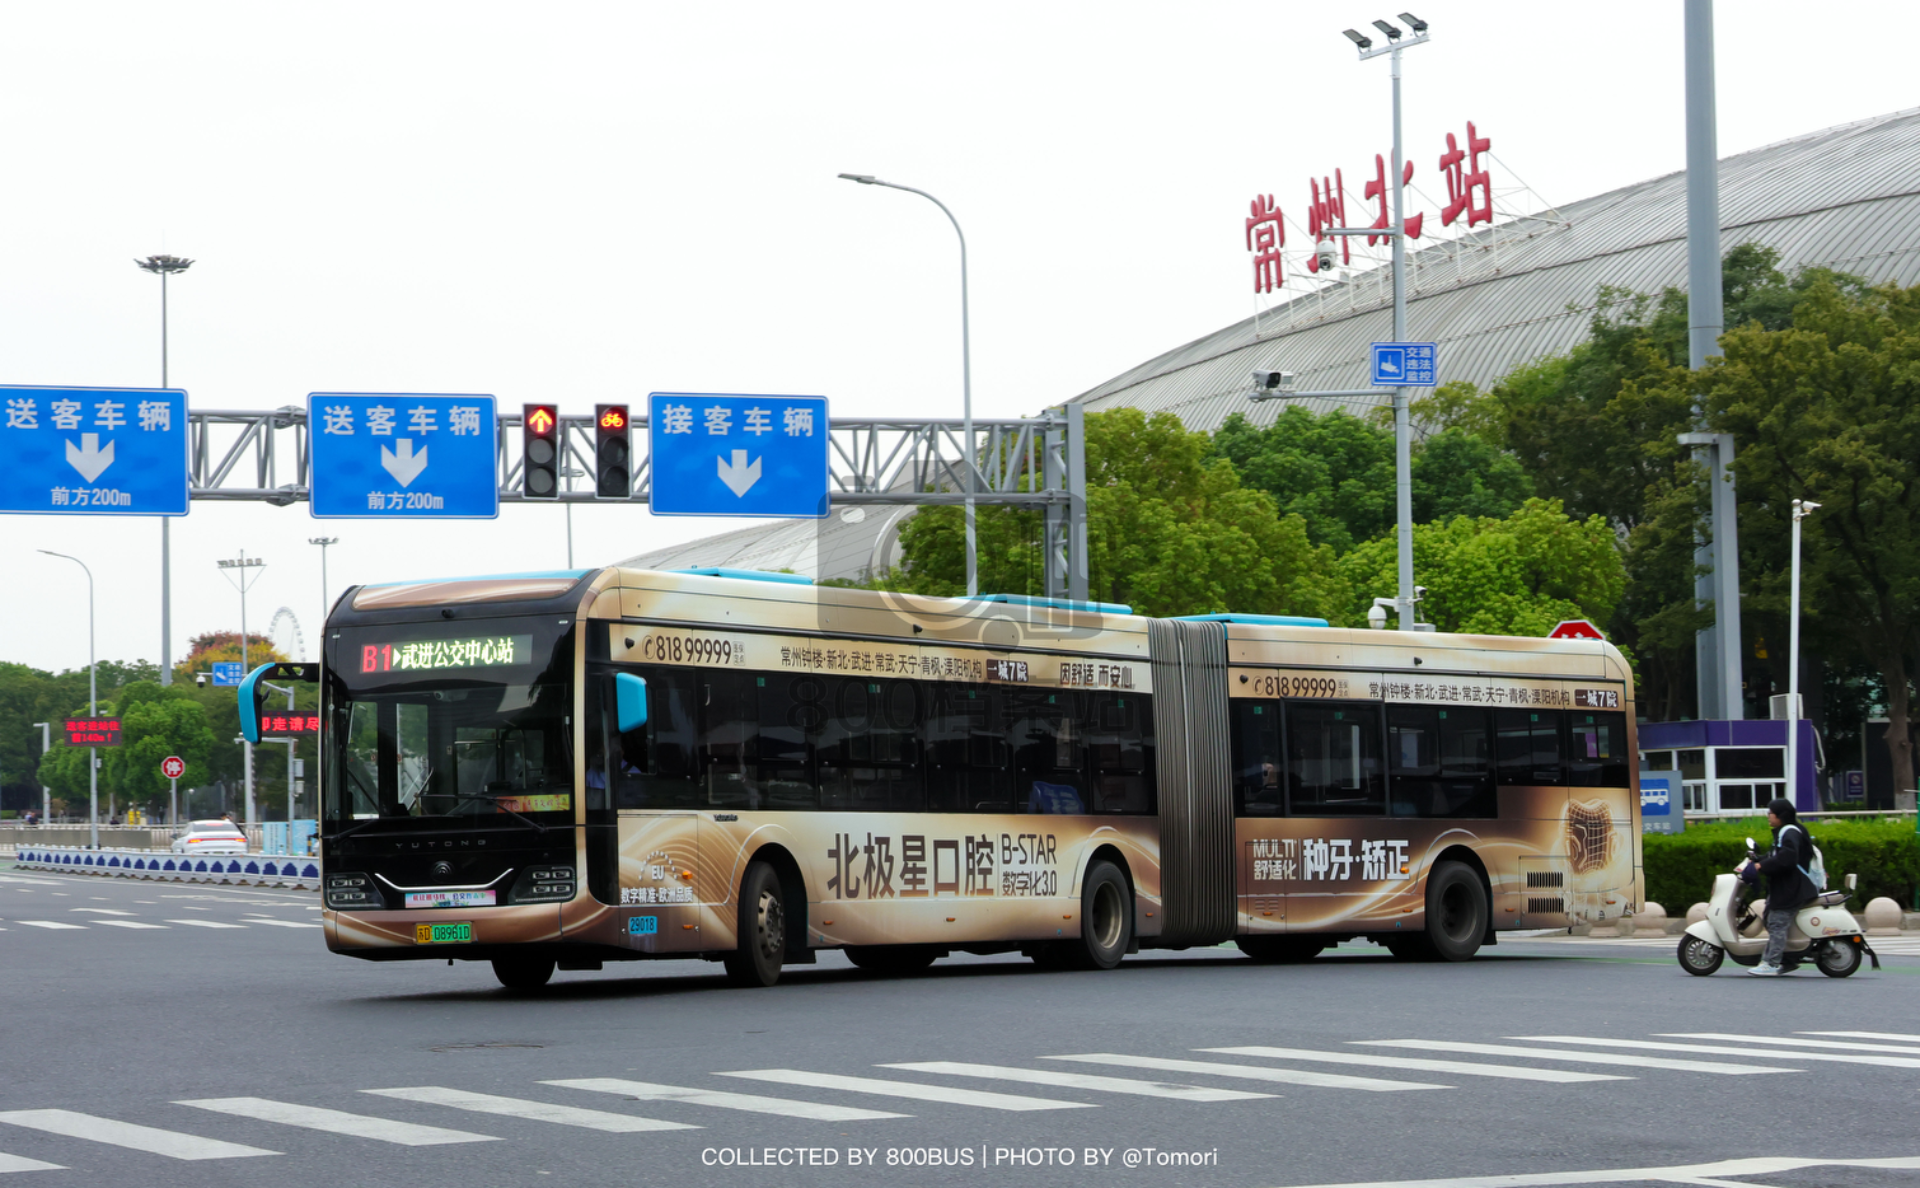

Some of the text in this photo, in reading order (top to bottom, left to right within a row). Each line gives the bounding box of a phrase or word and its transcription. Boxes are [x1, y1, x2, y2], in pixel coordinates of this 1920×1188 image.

[1246, 120, 1491, 293] 常州北站
[1406, 347, 1432, 358] 交通
[5, 398, 171, 432] 送客车辆
[323, 405, 481, 437] 送客车辆
[663, 404, 814, 437] 接客车辆
[50, 486, 132, 507] 前方200m
[366, 491, 444, 510] 前方200m
[362, 644, 392, 673] B1
[401, 636, 515, 670] 武进公交中心站
[395, 839, 486, 849] YUTONG
[1001, 834, 1057, 865] B-STAR
[651, 864, 665, 880] EU
[827, 832, 995, 899] 北极星口腔
[1254, 860, 1297, 880] 舒适化
[1303, 838, 1410, 881] 种牙·矫正
[1002, 870, 1058, 897] 数字化3.0
[630, 917, 655, 932] 29018
